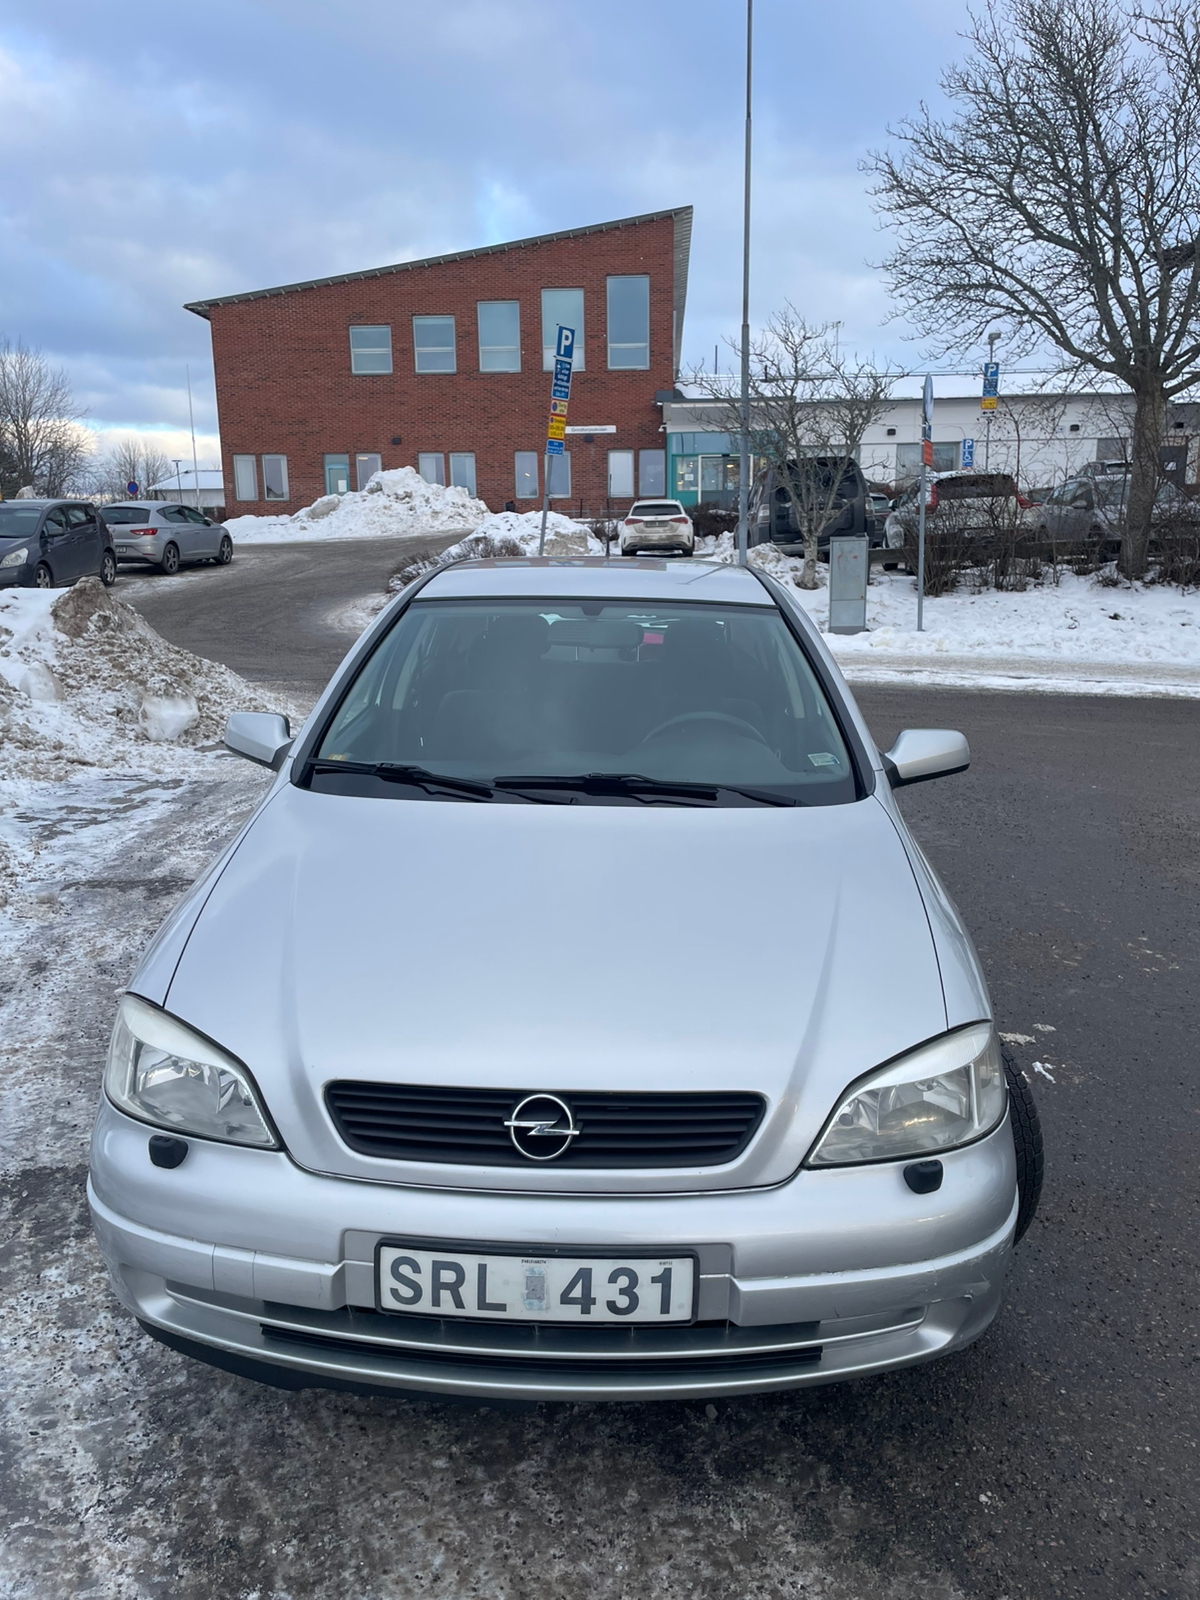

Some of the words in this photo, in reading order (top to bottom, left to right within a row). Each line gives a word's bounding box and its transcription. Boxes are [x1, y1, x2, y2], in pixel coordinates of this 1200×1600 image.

[560, 329, 572, 355] P
[988, 364, 996, 377] P
[965, 440, 972, 449] P
[389, 1256, 507, 1312] SRL
[559, 1267, 673, 1315] 431
